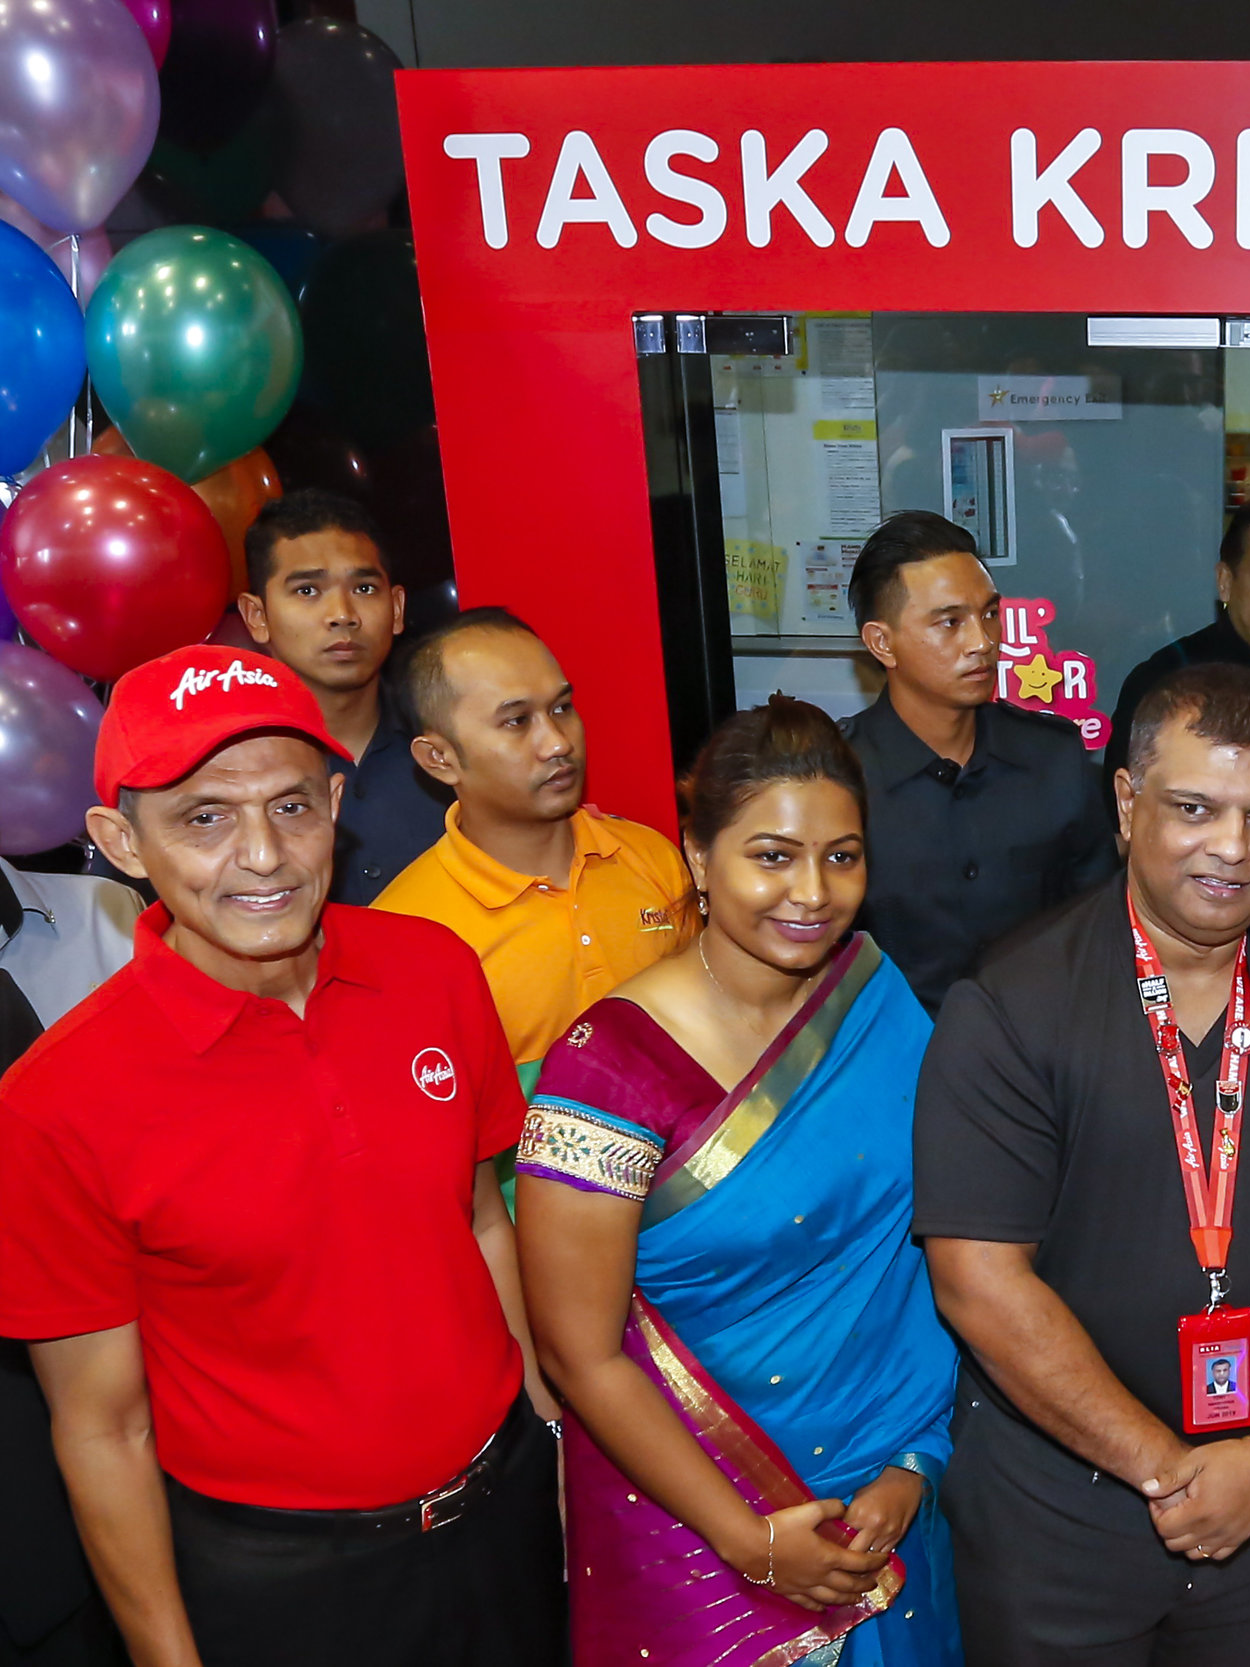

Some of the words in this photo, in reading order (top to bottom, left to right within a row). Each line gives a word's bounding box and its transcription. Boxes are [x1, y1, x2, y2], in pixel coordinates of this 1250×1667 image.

[443, 128, 951, 250] TASKA
[1010, 393, 1081, 406] Emergency
[725, 554, 781, 573] SELAMAT
[736, 570, 767, 586] HARI
